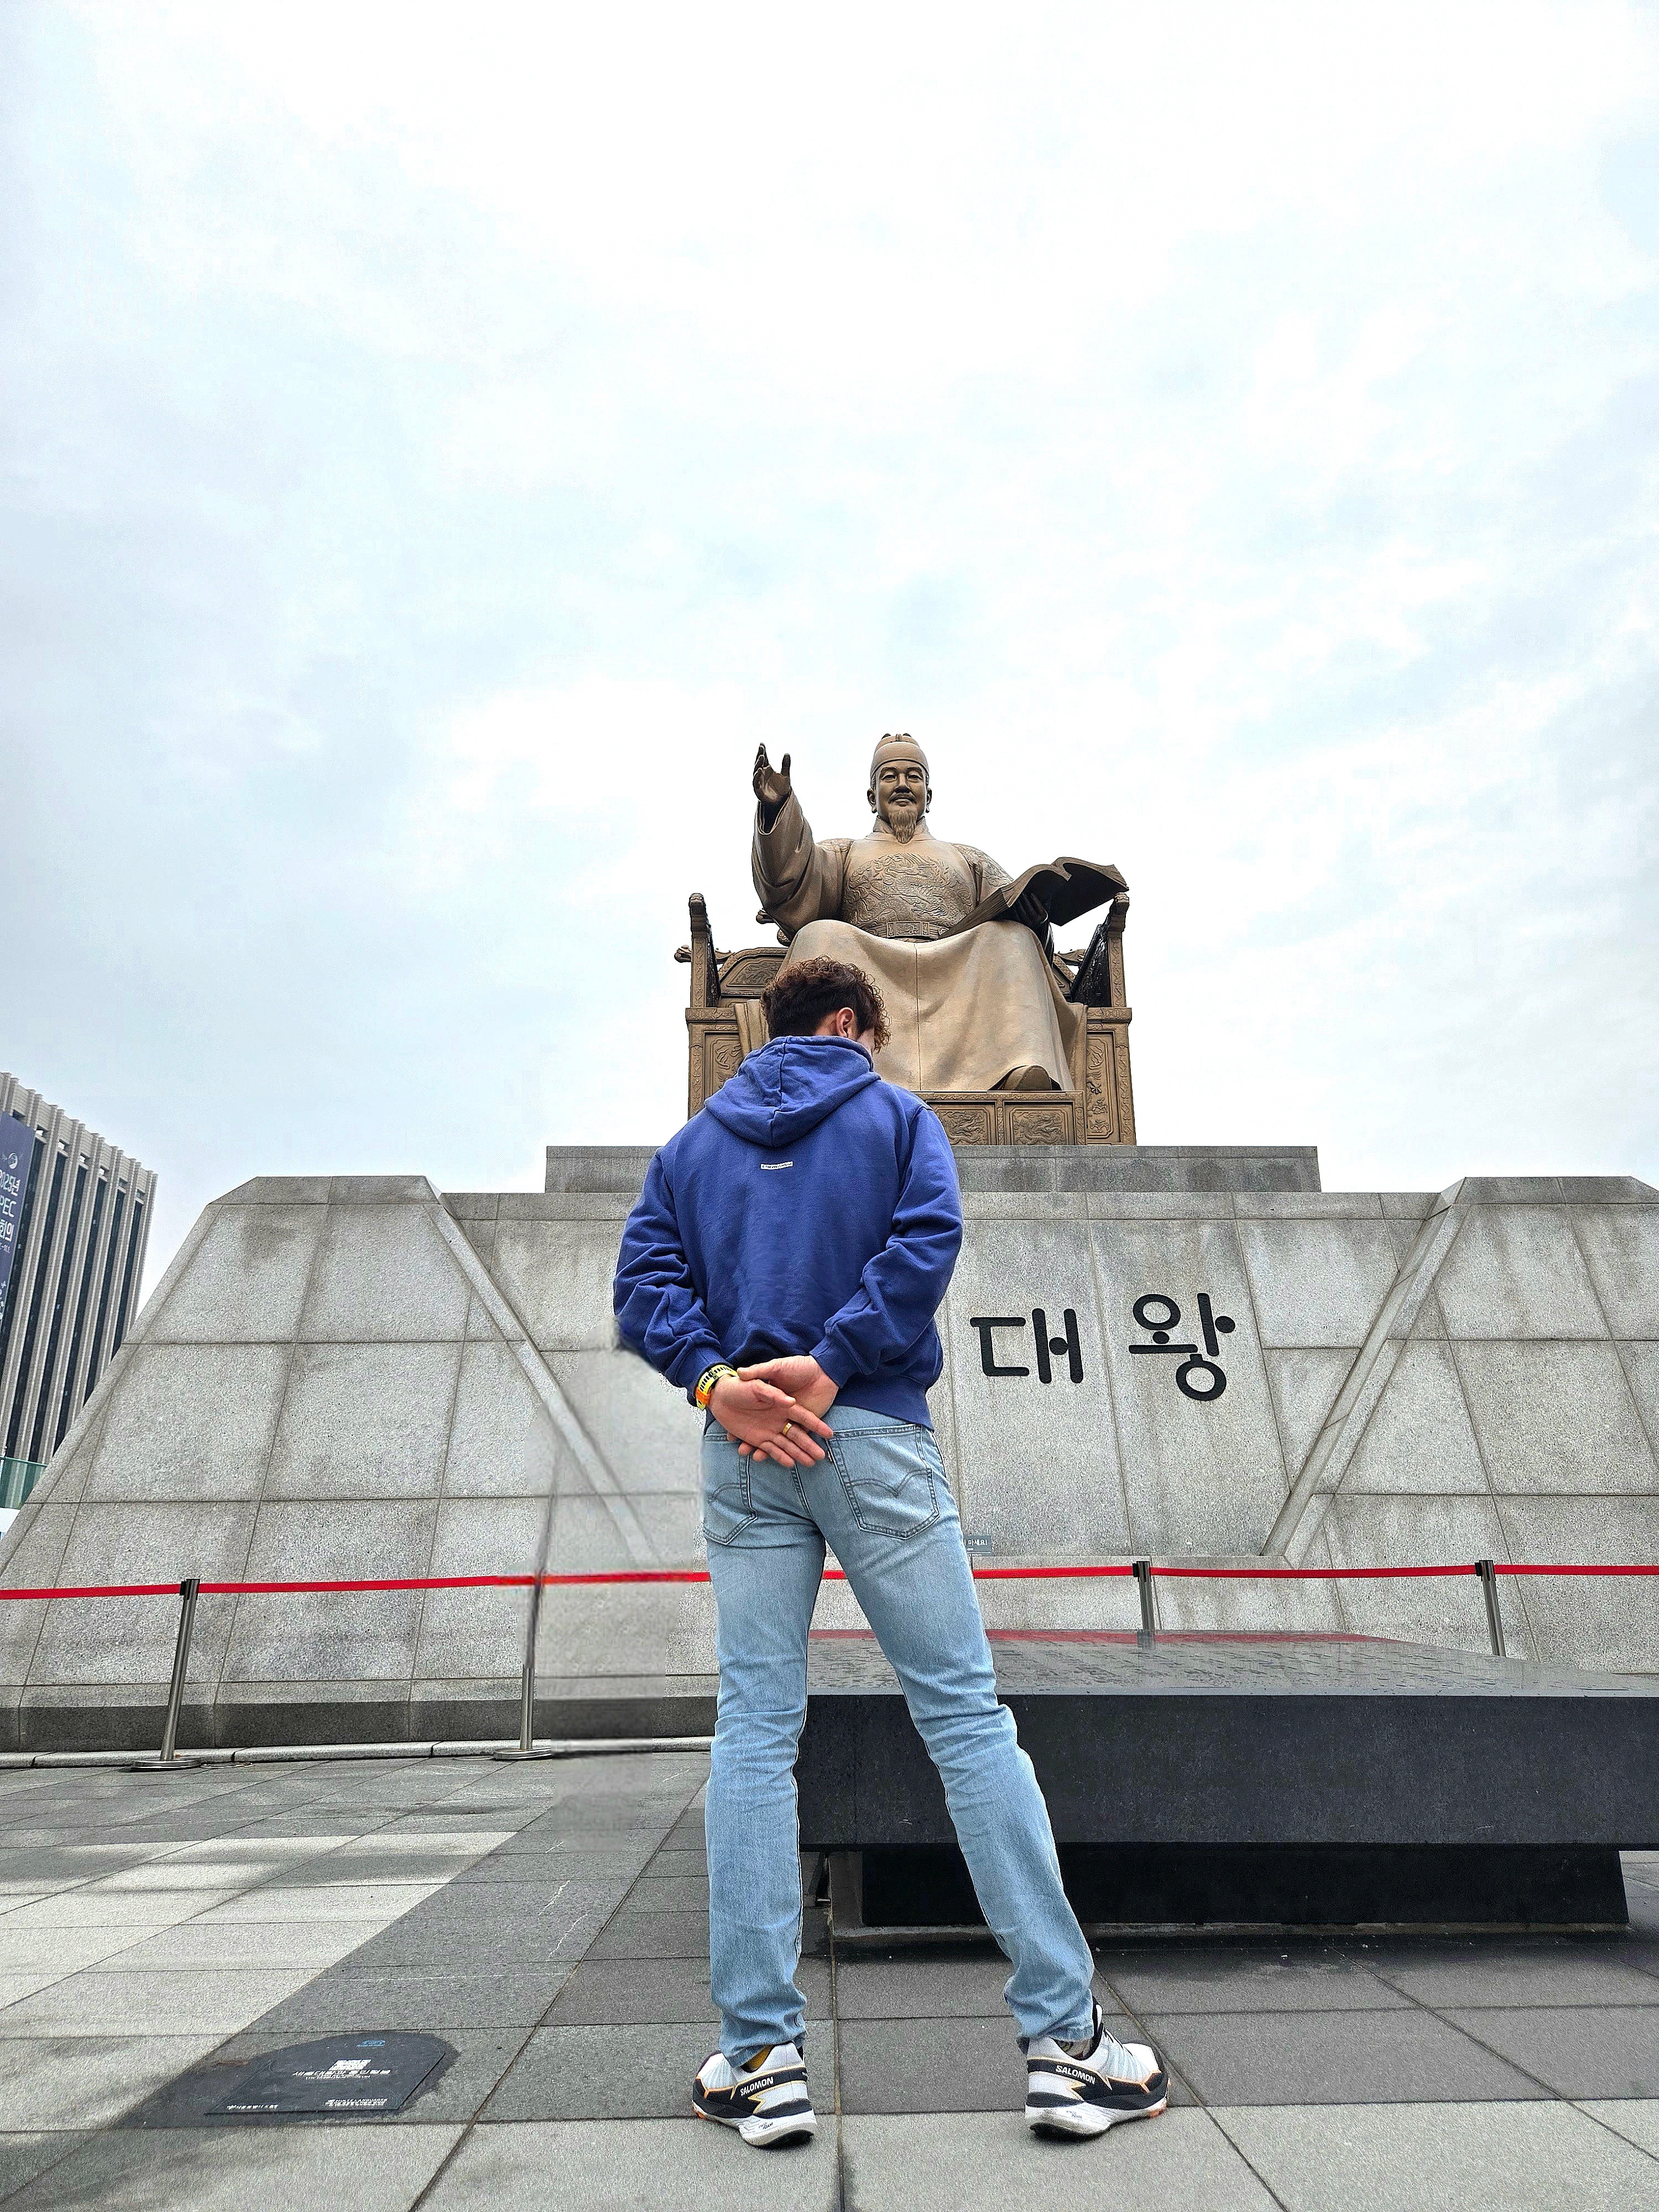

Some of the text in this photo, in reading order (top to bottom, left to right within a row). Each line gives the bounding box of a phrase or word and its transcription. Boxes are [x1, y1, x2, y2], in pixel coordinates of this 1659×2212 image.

[970, 1292, 1236, 1401] 대왕
[1055, 2065, 1095, 2085] SALOMON
[740, 2076, 774, 2096] SALOMON
